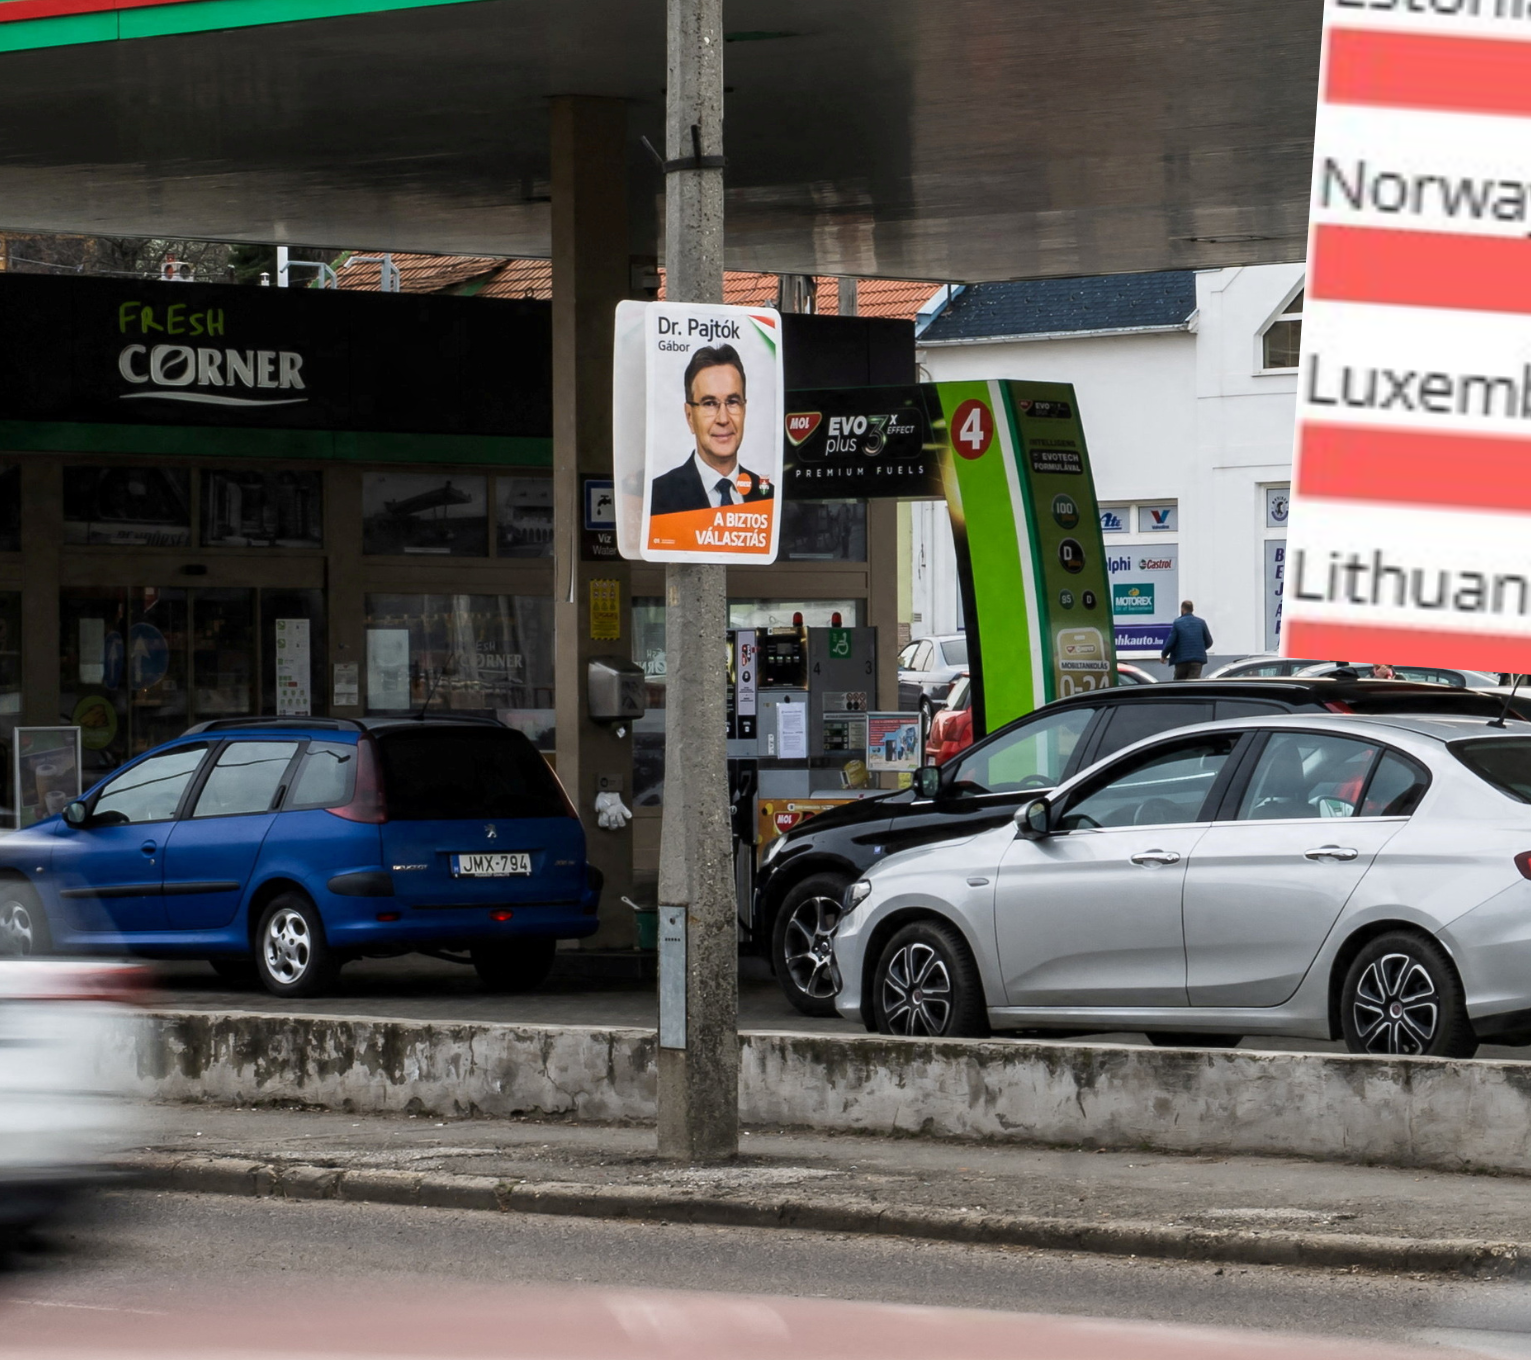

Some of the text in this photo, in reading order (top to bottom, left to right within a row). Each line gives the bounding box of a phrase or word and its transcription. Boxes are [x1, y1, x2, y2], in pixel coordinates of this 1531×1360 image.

[658, 316, 740, 342] Dr. Pajtók
[658, 340, 690, 352] Gábor
[119, 344, 305, 389] CORNER
[790, 417, 810, 429] MOL
[828, 415, 868, 436] EVO
[959, 408, 984, 450] 4
[825, 425, 915, 456] plus EFFECT
[1041, 452, 1079, 462] EVOTECH
[795, 465, 924, 478] PREMIUM FUELS
[1056, 502, 1073, 515] 100
[714, 512, 768, 528] A BIZTOS
[695, 529, 766, 547] VÁLASZTÁS
[592, 544, 617, 555] Water
[1063, 546, 1073, 561] D
[1146, 559, 1172, 570] Castrol
[1115, 596, 1153, 606] MOTOREX
[813, 662, 821, 676] 4
[865, 660, 873, 675] 3
[777, 814, 793, 824] MOL
[463, 855, 529, 873] JMX-794
